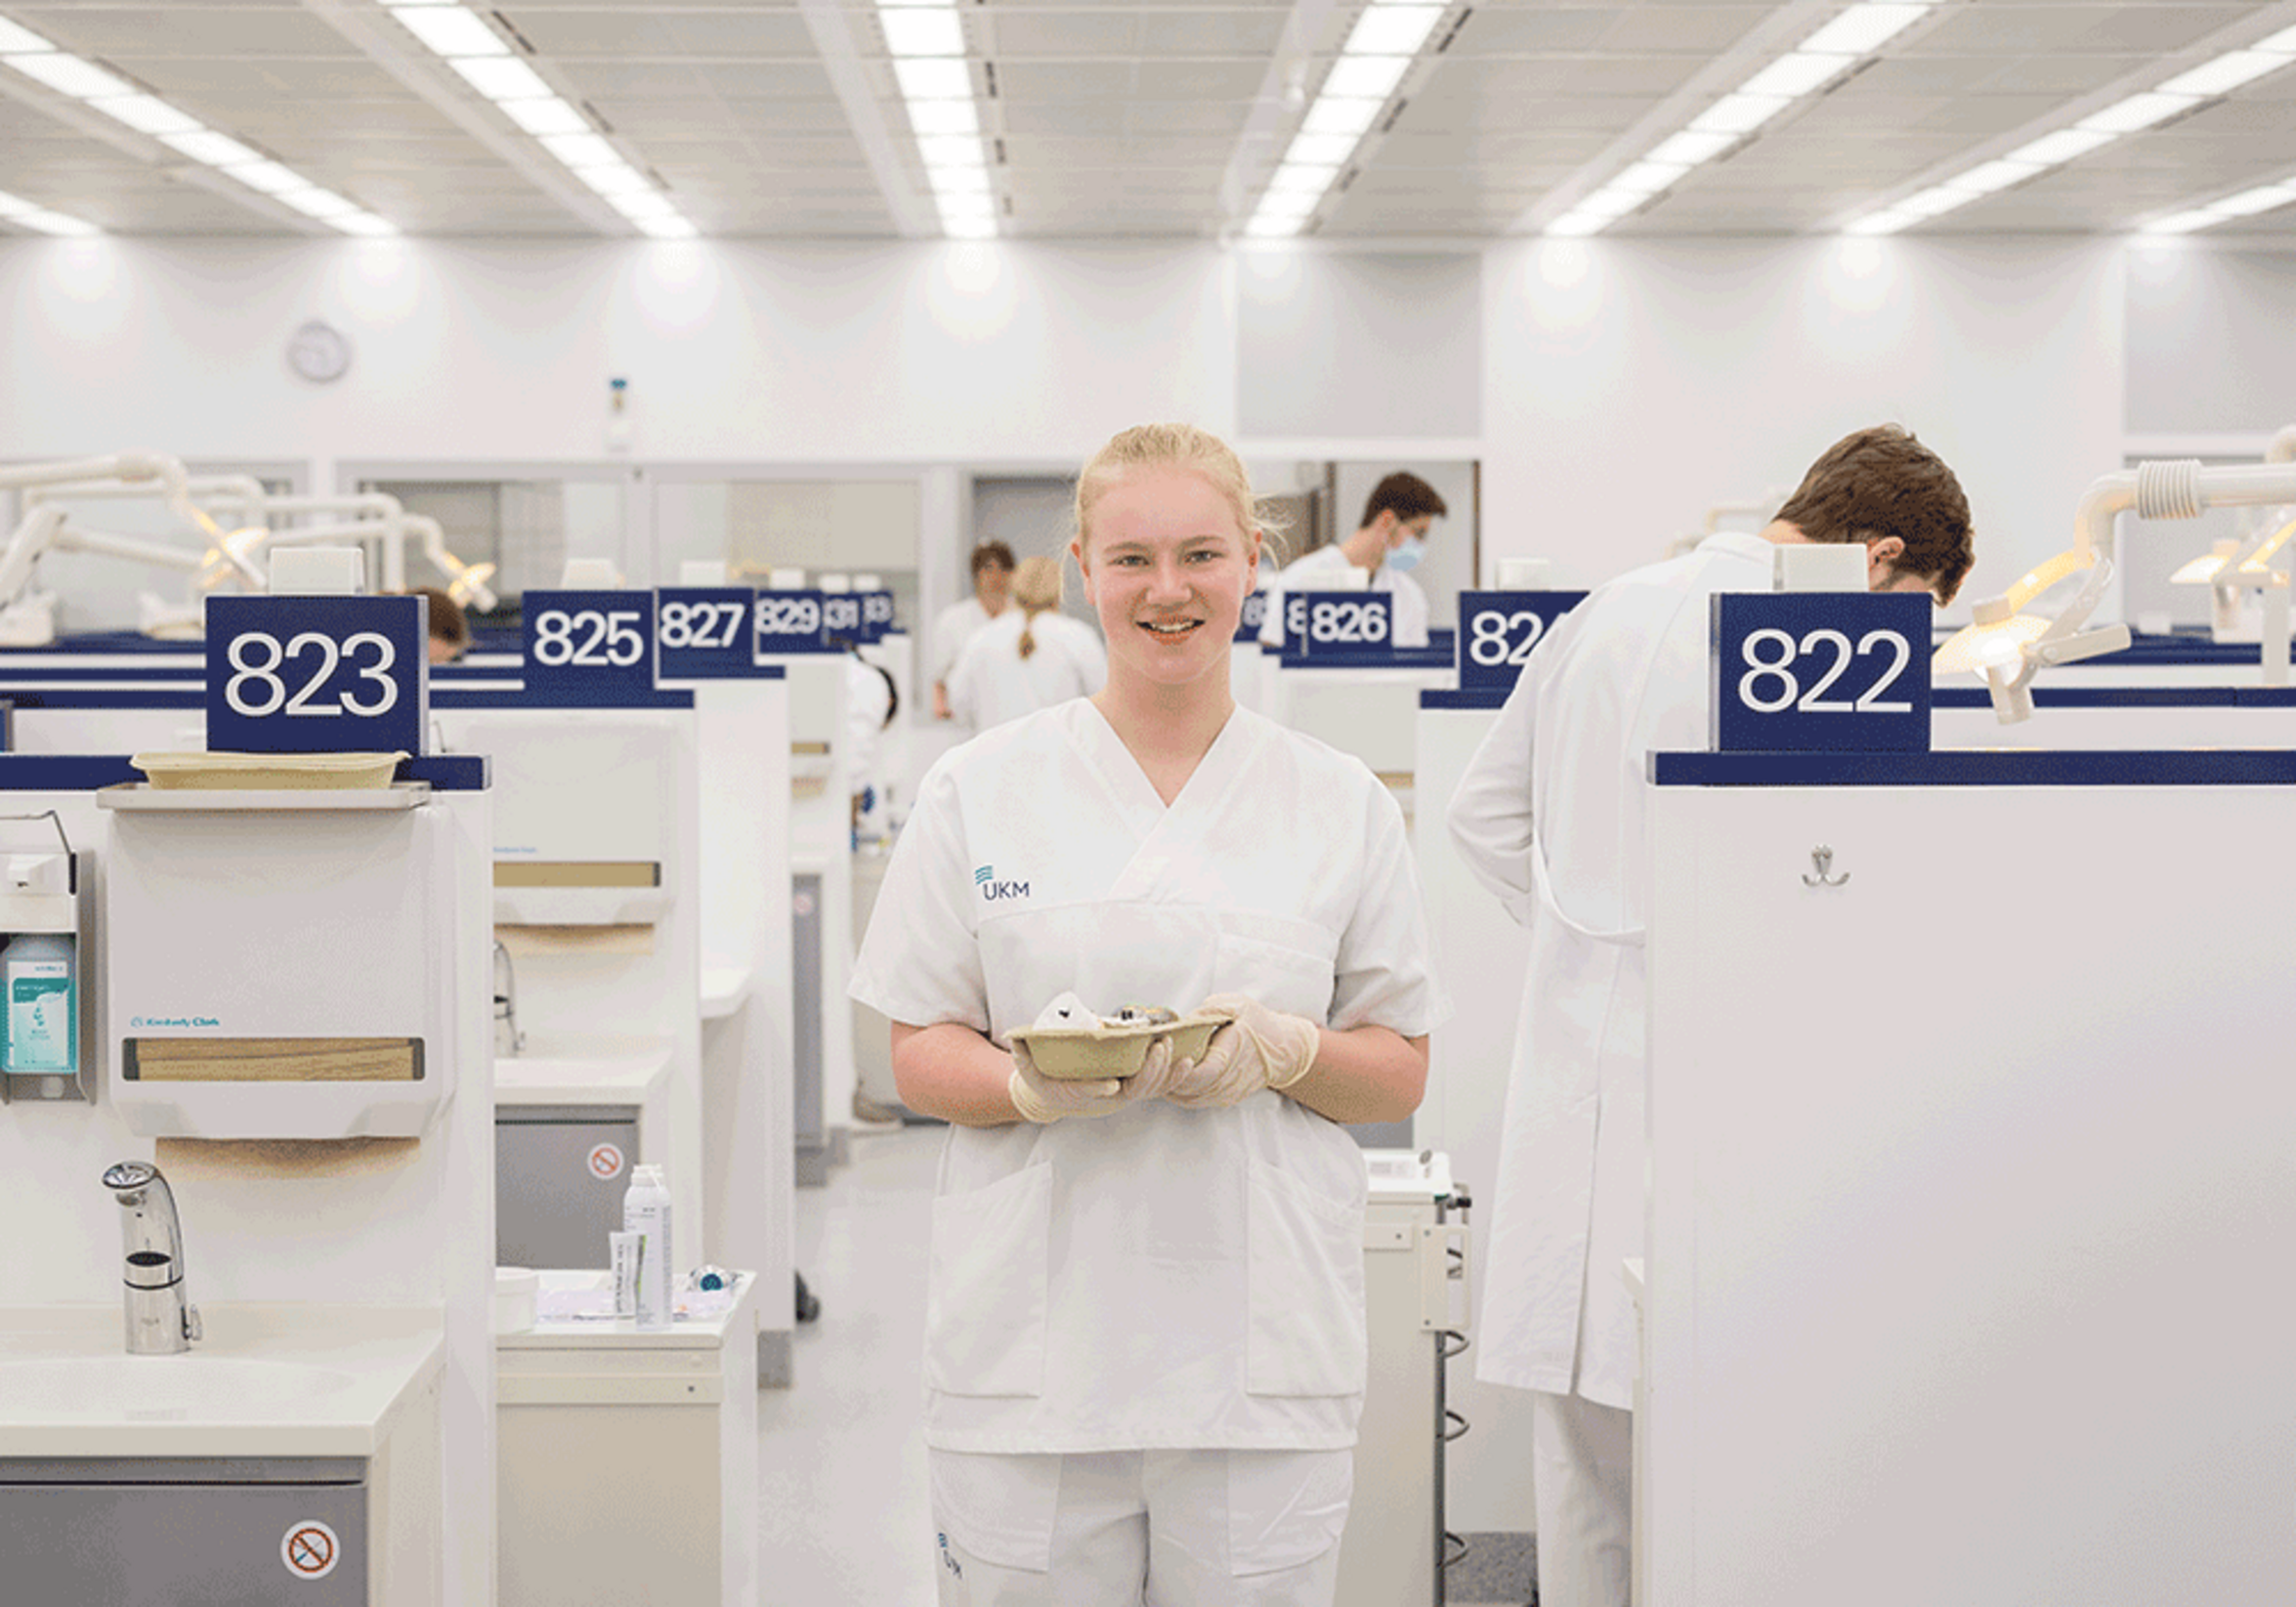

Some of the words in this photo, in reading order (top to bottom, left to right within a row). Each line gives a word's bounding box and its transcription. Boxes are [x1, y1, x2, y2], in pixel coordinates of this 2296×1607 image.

[659, 602, 745, 648] 827
[754, 598, 820, 634] 829
[823, 599, 859, 629] 31
[1311, 602, 1387, 642] 826
[533, 611, 644, 666] 825
[1469, 611, 1544, 665] 82
[225, 632, 398, 717] 823
[1738, 628, 1912, 713] 822
[983, 880, 1030, 901] UKM
